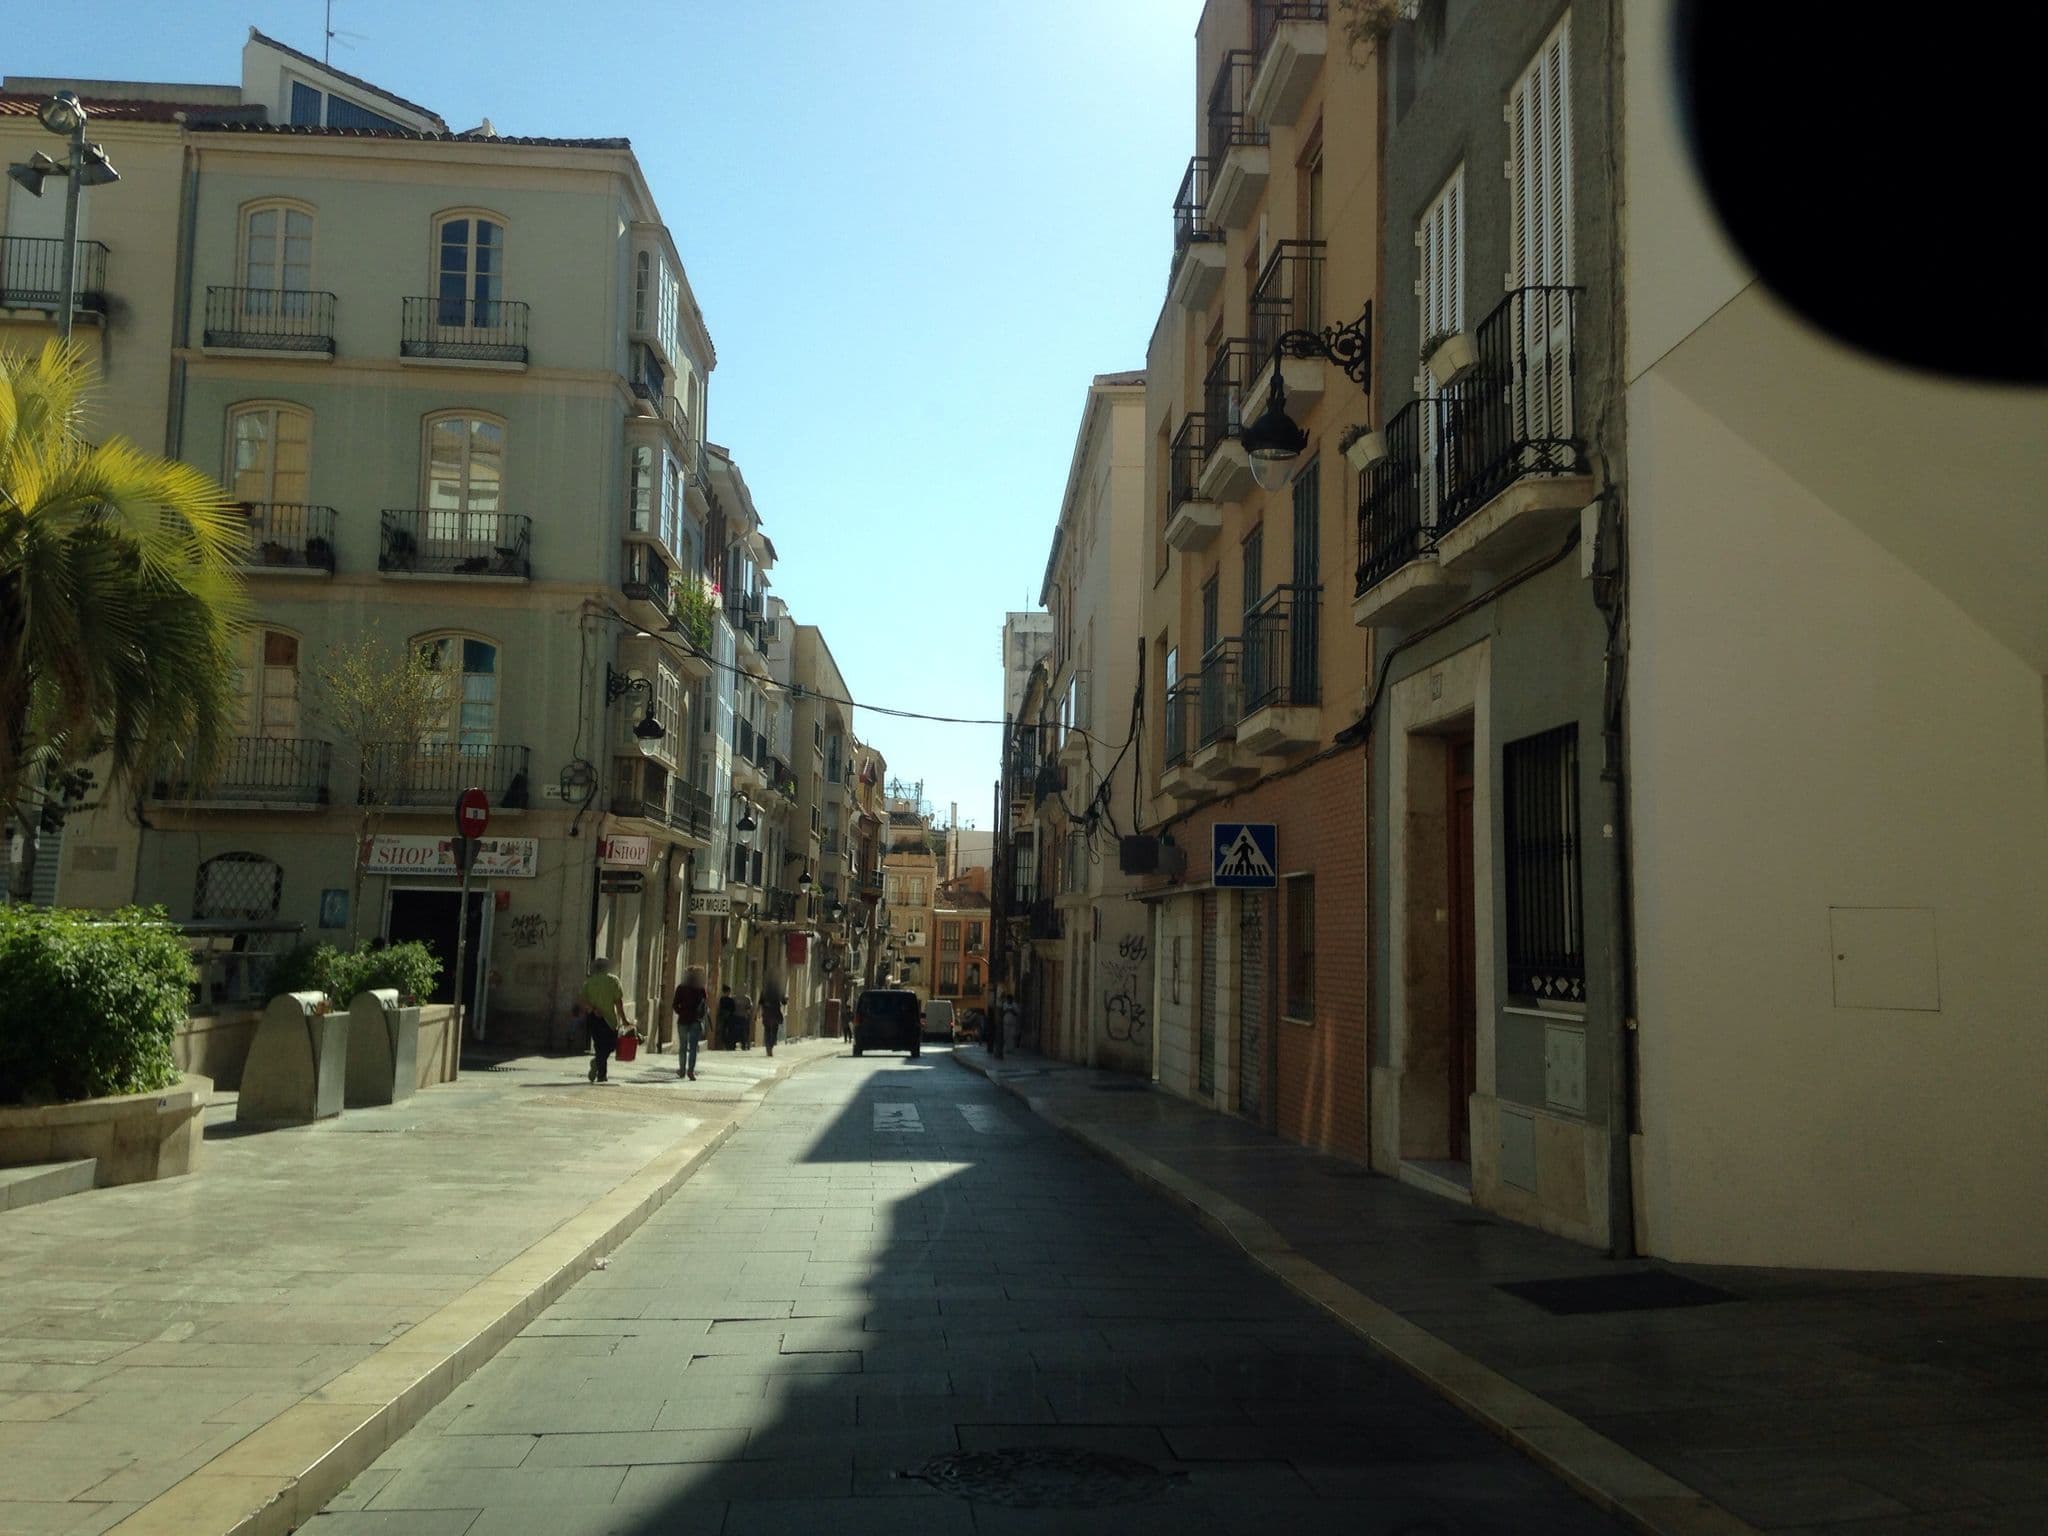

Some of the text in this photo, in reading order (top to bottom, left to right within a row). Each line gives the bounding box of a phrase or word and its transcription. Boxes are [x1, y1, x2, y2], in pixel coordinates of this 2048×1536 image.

[377, 847, 434, 865] SHOP
[615, 846, 646, 860] SHOP
[690, 898, 730, 913] BAR MIGUEL
